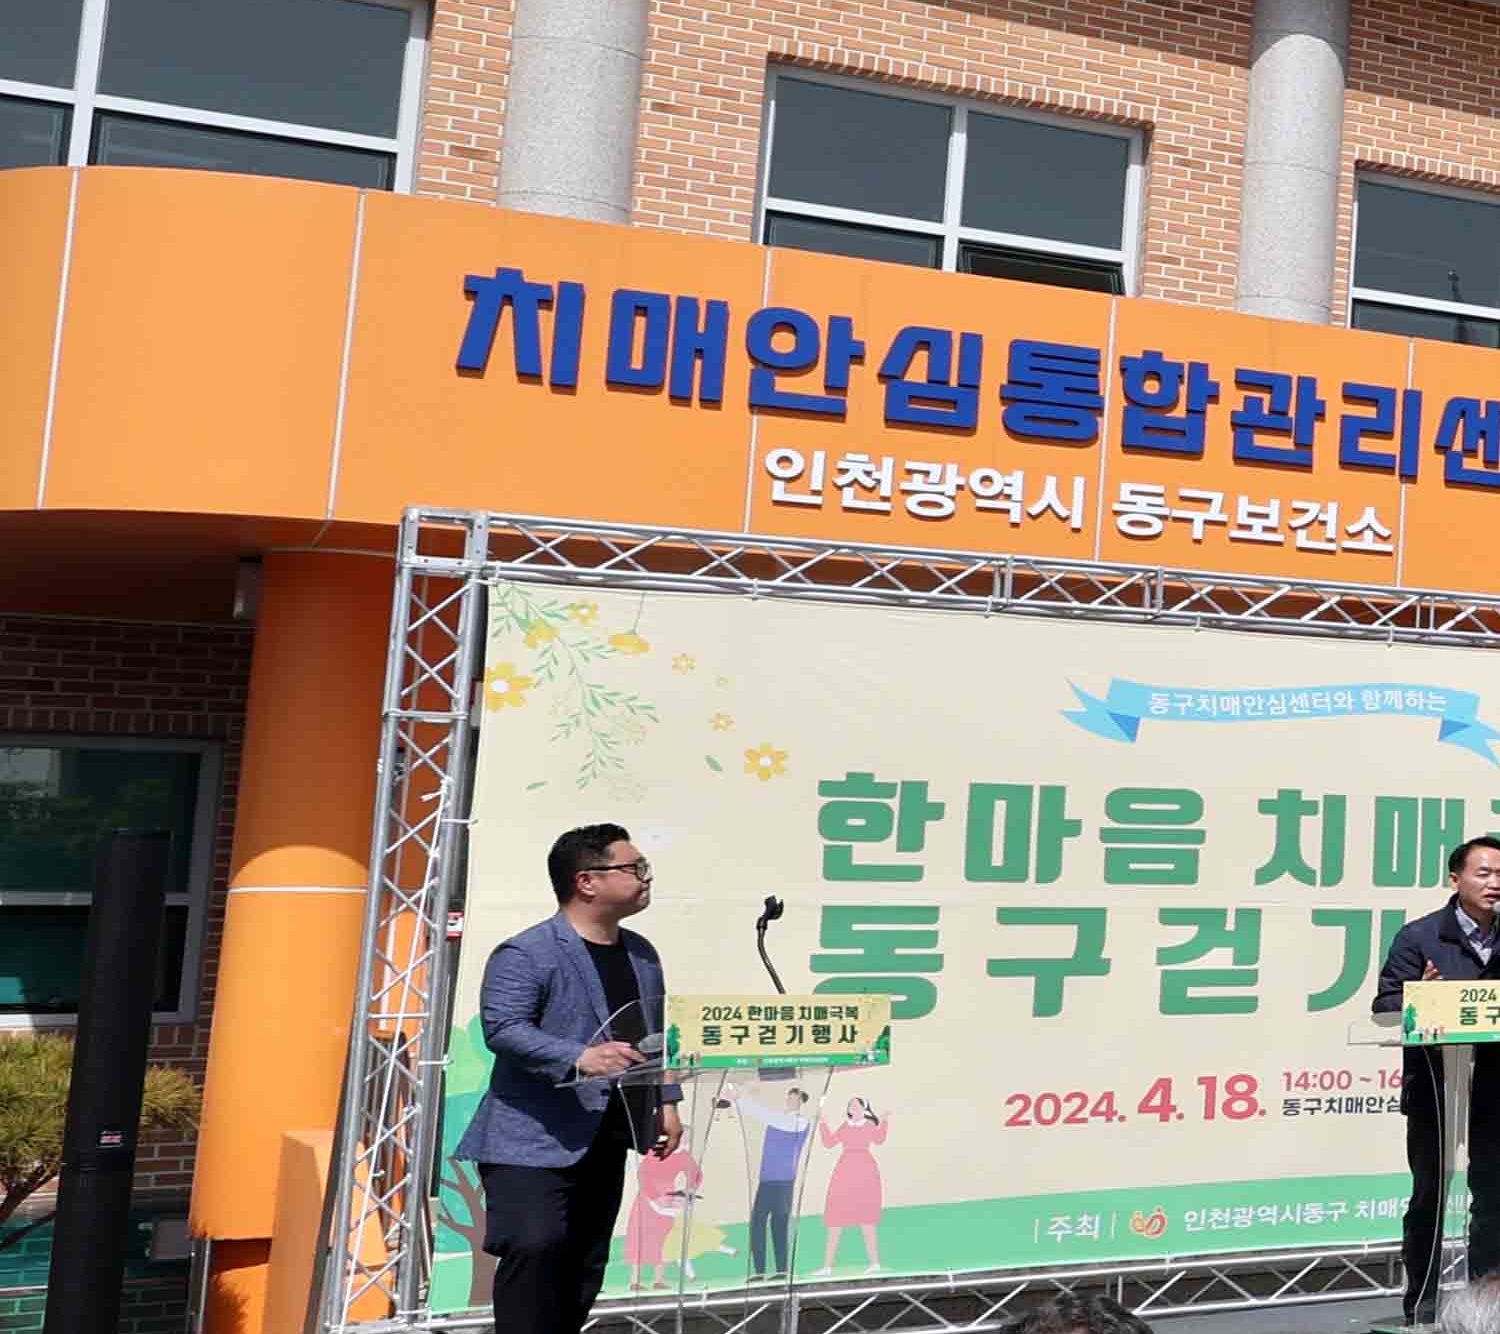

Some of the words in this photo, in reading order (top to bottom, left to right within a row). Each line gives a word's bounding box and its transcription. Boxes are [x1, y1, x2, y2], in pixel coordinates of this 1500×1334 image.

[764, 446, 1088, 529] 인천광역시
[1112, 481, 1395, 555] 동구보건소
[1147, 691, 1355, 716] 동구치매안심센터와
[1360, 689, 1448, 713] 함께하는
[816, 771, 1207, 888] 한마음
[1459, 988, 1497, 1002] 2024
[702, 1007, 742, 1021] 2024
[1282, 1069, 1352, 1091] 14:00
[1004, 1092, 1127, 1127] 2024.
[1137, 1077, 1185, 1123] 4.
[1198, 1073, 1267, 1122] 18.
